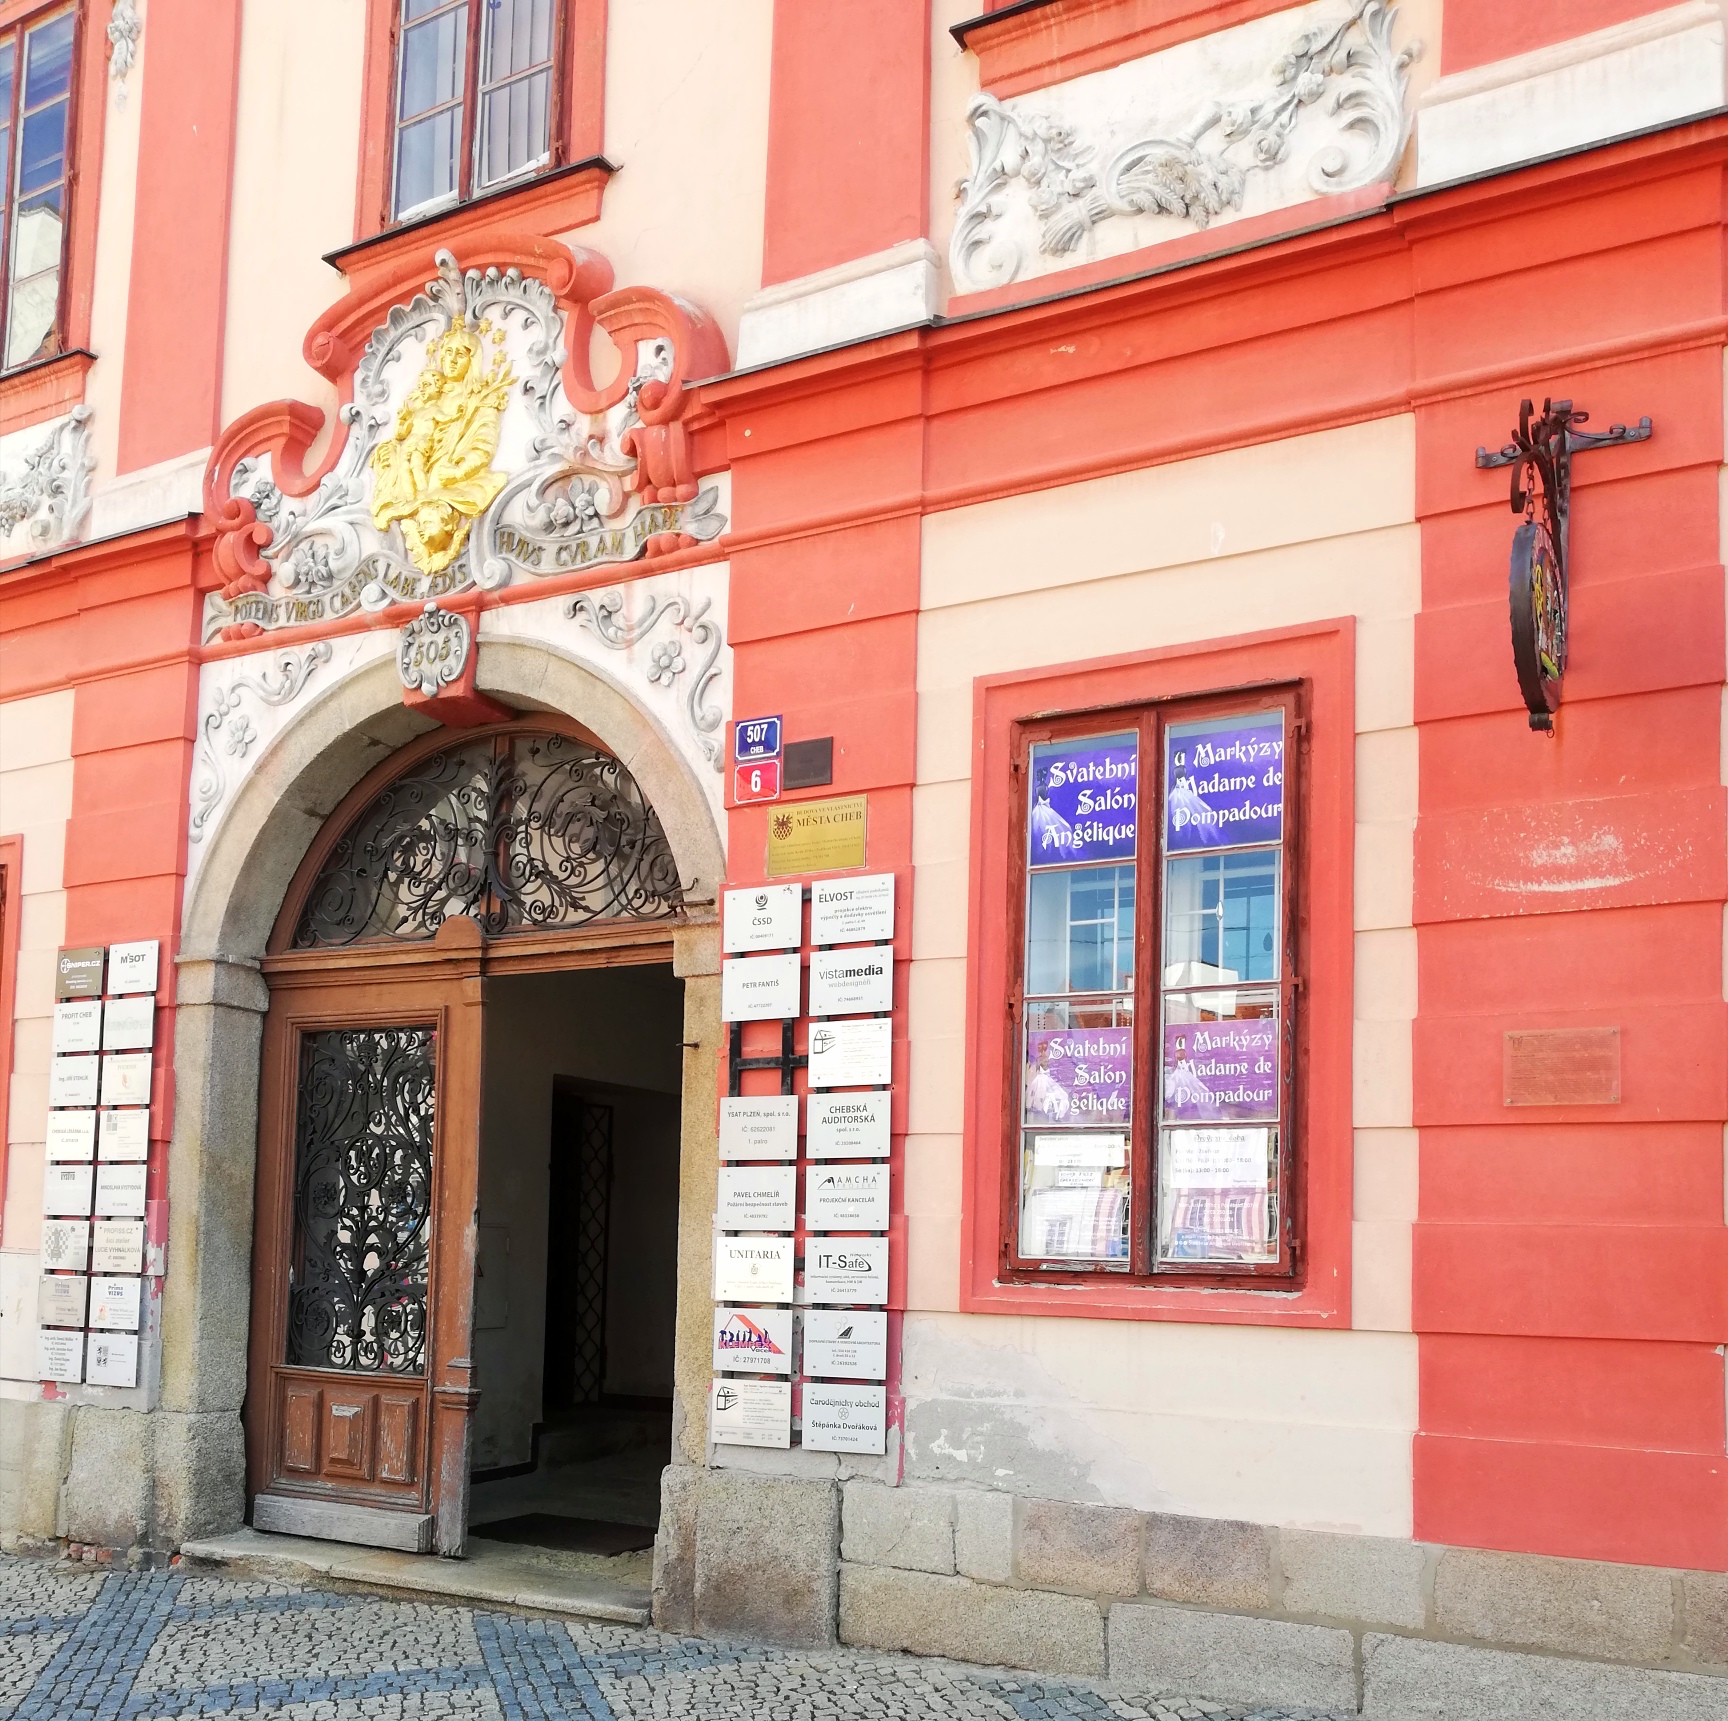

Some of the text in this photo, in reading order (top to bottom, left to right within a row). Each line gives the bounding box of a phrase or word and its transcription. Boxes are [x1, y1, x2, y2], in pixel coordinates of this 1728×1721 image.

[747, 724, 768, 743] 507
[750, 746, 763, 754] CHEB
[1174, 737, 1283, 767] u Markýzy
[751, 770, 761, 792] 6
[1048, 754, 1137, 788] Svatební
[1176, 767, 1282, 797] Madame de
[1076, 787, 1135, 816] Salón
[797, 811, 862, 827] MĚSTA CHEB
[1172, 801, 1282, 831] Pompadour
[1042, 822, 1135, 850] Angélique
[819, 891, 854, 903] ELVOST
[752, 917, 772, 926] ČSSD
[819, 964, 883, 980] vistamedia
[742, 980, 779, 989] PETR FANTIŠ
[1048, 1035, 1127, 1059] Svatební
[1176, 1031, 1273, 1053] u Markýzy
[1073, 1064, 1126, 1086] Salón
[1178, 1054, 1272, 1078] Madame de
[1043, 1091, 1126, 1120] Angélique
[1175, 1085, 1273, 1107] Pompadour
[822, 1113, 876, 1124] AUDITORSKÁ
[829, 1103, 868, 1114] CHEBSKÁ
[837, 1176, 877, 1184] AMCHA
[729, 1249, 781, 1259] UNITARIA
[819, 1254, 865, 1269] IT-Safe
[812, 1420, 841, 1429] Štěpánka
